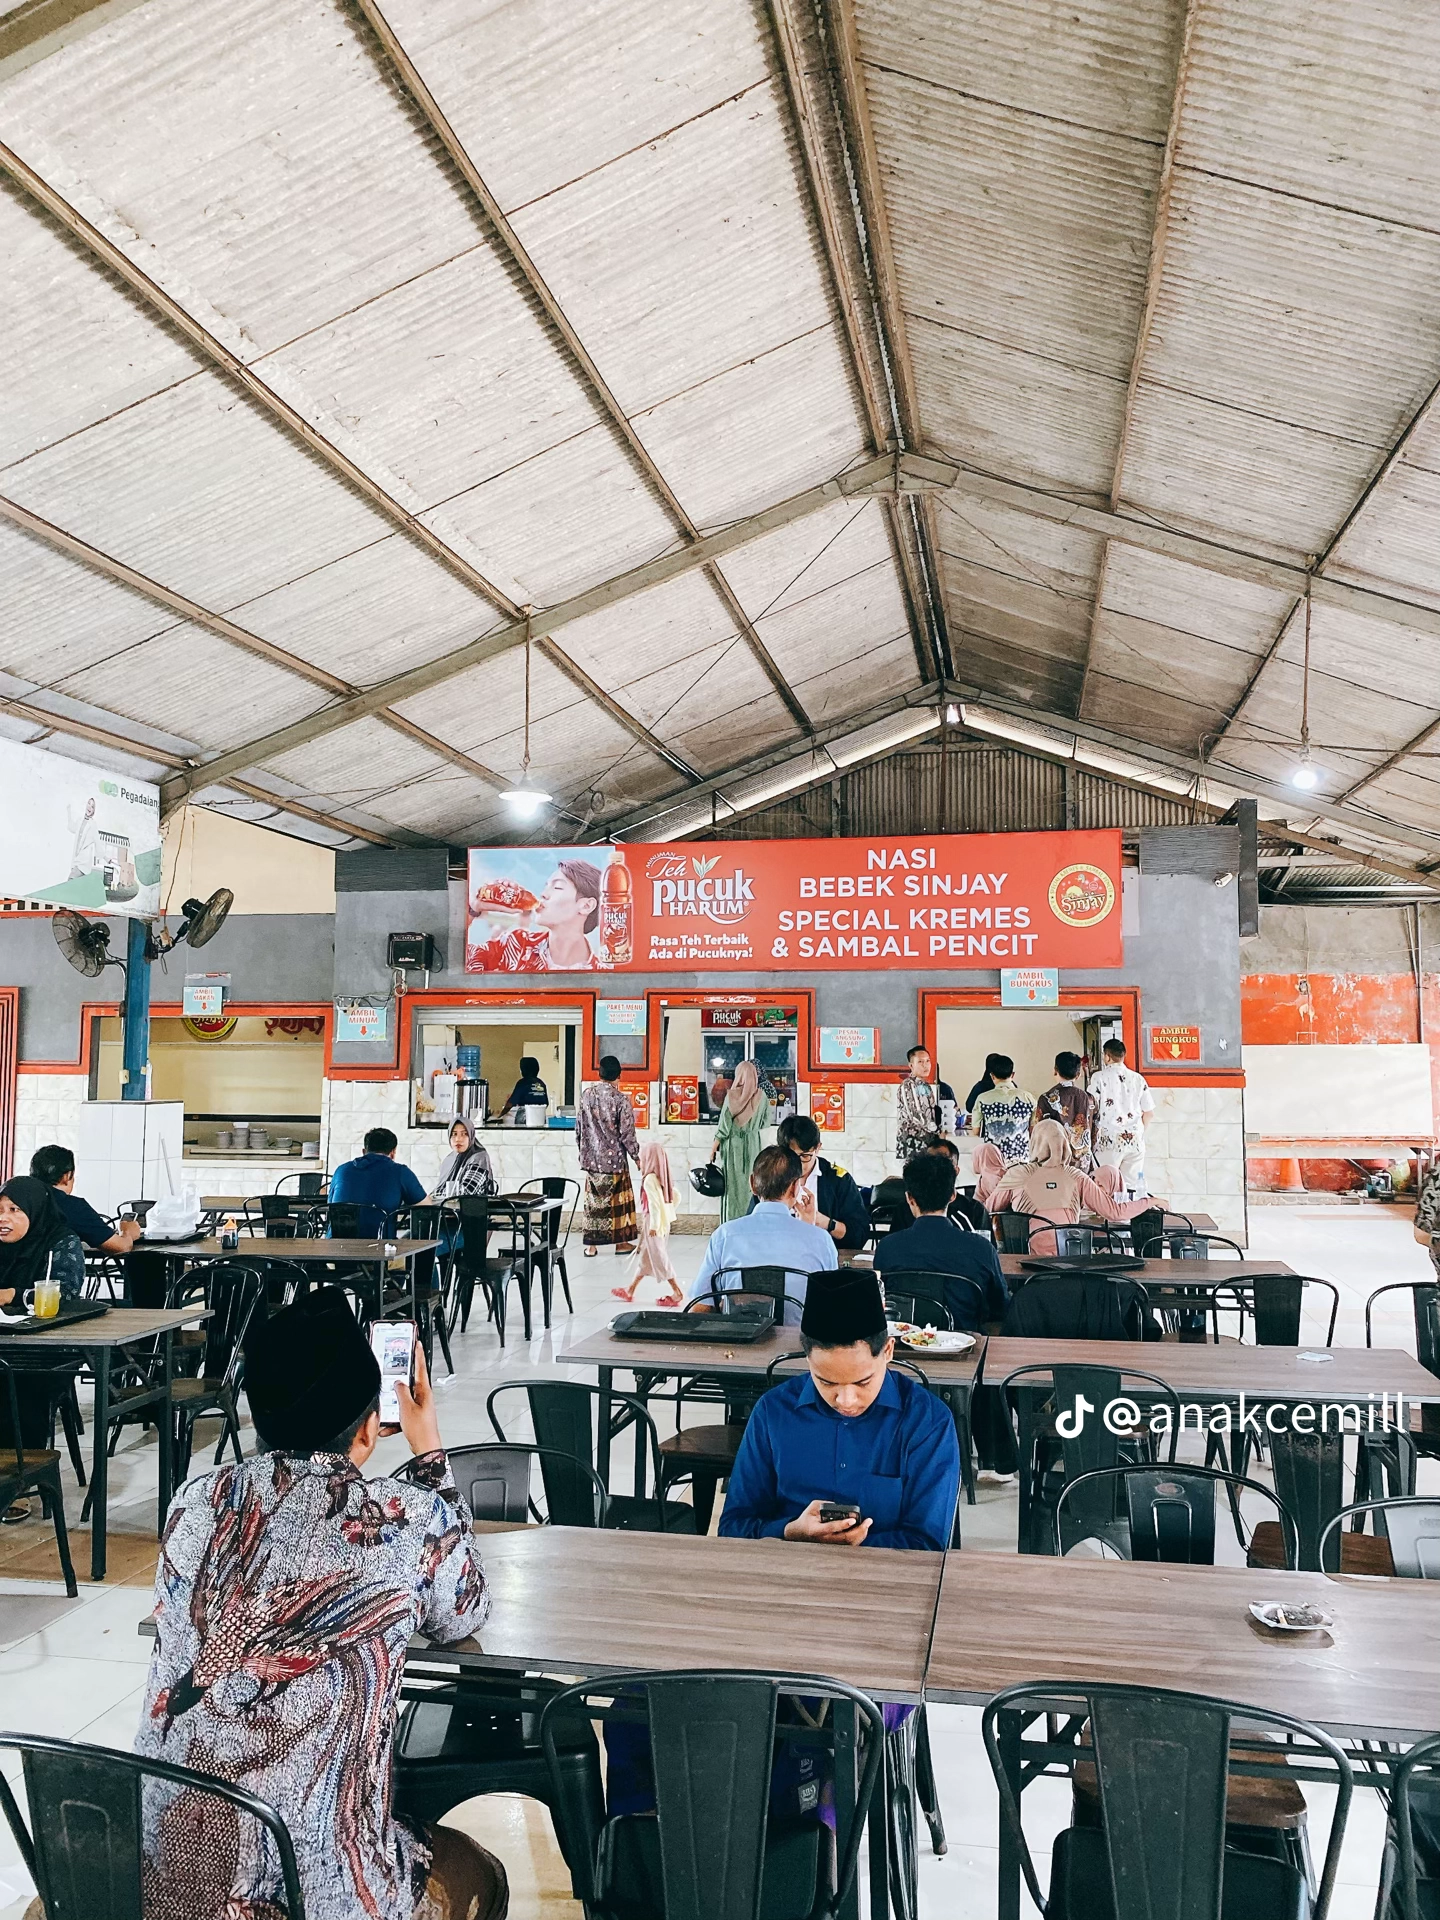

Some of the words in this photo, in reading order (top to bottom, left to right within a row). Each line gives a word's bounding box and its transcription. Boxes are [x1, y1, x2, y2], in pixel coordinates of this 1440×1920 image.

[120, 787, 158, 807] Pegadaian
[646, 851, 676, 868] MINUMAN
[646, 856, 687, 879] Teh
[868, 848, 936, 870] NASI
[652, 870, 755, 916] pucuk
[800, 876, 895, 898] BEBEK
[903, 873, 1008, 896] SINJAY
[1061, 894, 1105, 913] Sinjay
[778, 909, 899, 931] SPECIAL
[909, 907, 1031, 930] KREMES
[650, 935, 678, 946] Rasa
[680, 934, 701, 945] Teh
[704, 933, 749, 945] Terbaik
[771, 937, 789, 958] &
[798, 935, 919, 957] SAMBAL
[929, 934, 1038, 956] PENCIT
[648, 948, 672, 959] Ada
[675, 947, 687, 958] di
[689, 947, 753, 960] Pucuknya!
